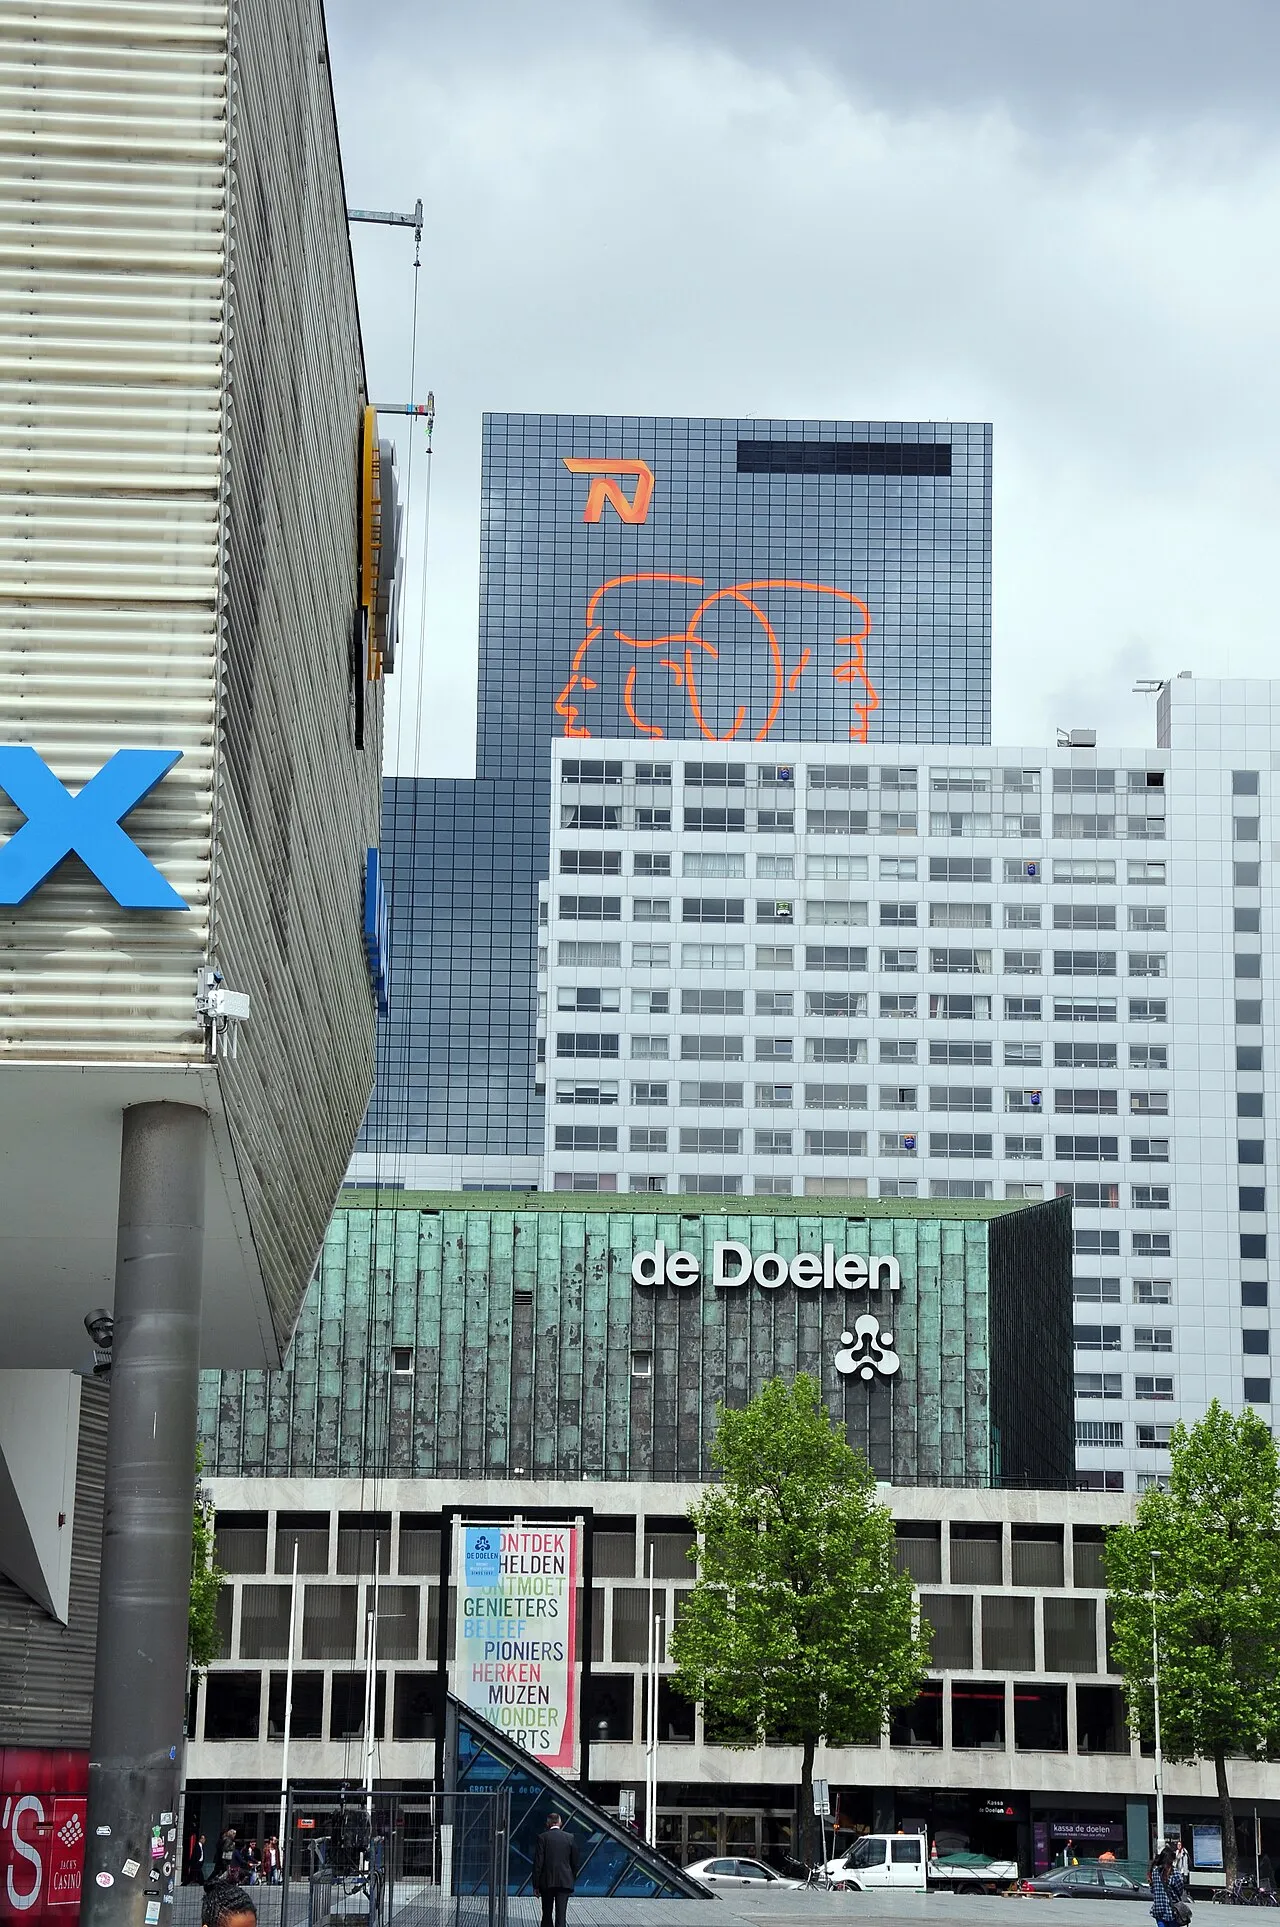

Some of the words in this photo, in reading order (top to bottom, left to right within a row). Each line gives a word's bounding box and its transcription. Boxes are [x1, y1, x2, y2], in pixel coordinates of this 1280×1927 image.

[0, 746, 190, 911] X
[632, 1239, 699, 1287] de
[713, 1241, 900, 1290] Doelen
[500, 1534, 565, 1553] ONTDEK
[475, 1552, 499, 1560] DOELEN
[499, 1555, 565, 1574] HELDEN
[464, 1598, 559, 1618] GENIETERS
[464, 1619, 527, 1639] BELEEF
[484, 1641, 564, 1661] PIONIERS
[472, 1663, 541, 1682] HERKEN
[489, 1685, 549, 1705] MUZEN
[474, 1707, 559, 1727] WONDER
[1053, 1824, 1074, 1832] kassa
[1075, 1825, 1085, 1833] de
[1086, 1825, 1110, 1833] doelen
[53, 1871, 81, 1890] CASINO
